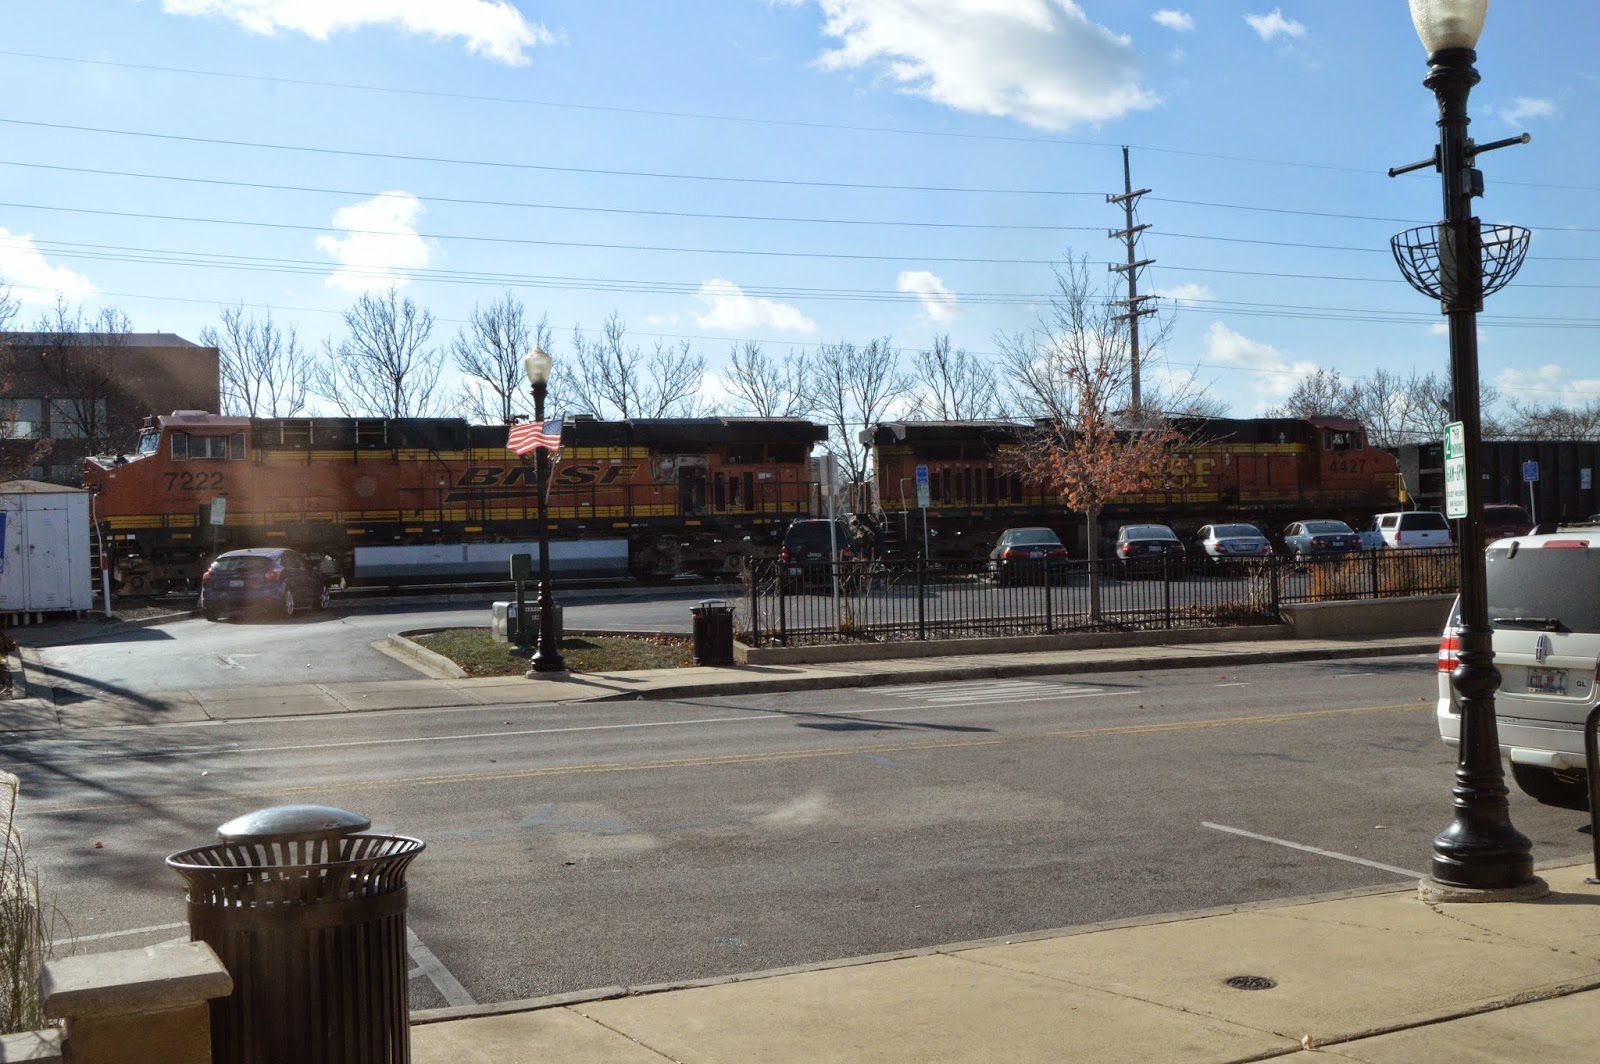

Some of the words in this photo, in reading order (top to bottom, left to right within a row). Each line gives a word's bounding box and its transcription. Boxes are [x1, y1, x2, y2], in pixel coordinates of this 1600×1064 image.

[1445, 432, 1450, 454] 2
[455, 465, 641, 487] BNSF
[1132, 457, 1217, 489] NSF
[1328, 459, 1367, 473] 4427
[163, 471, 225, 491] 7222
